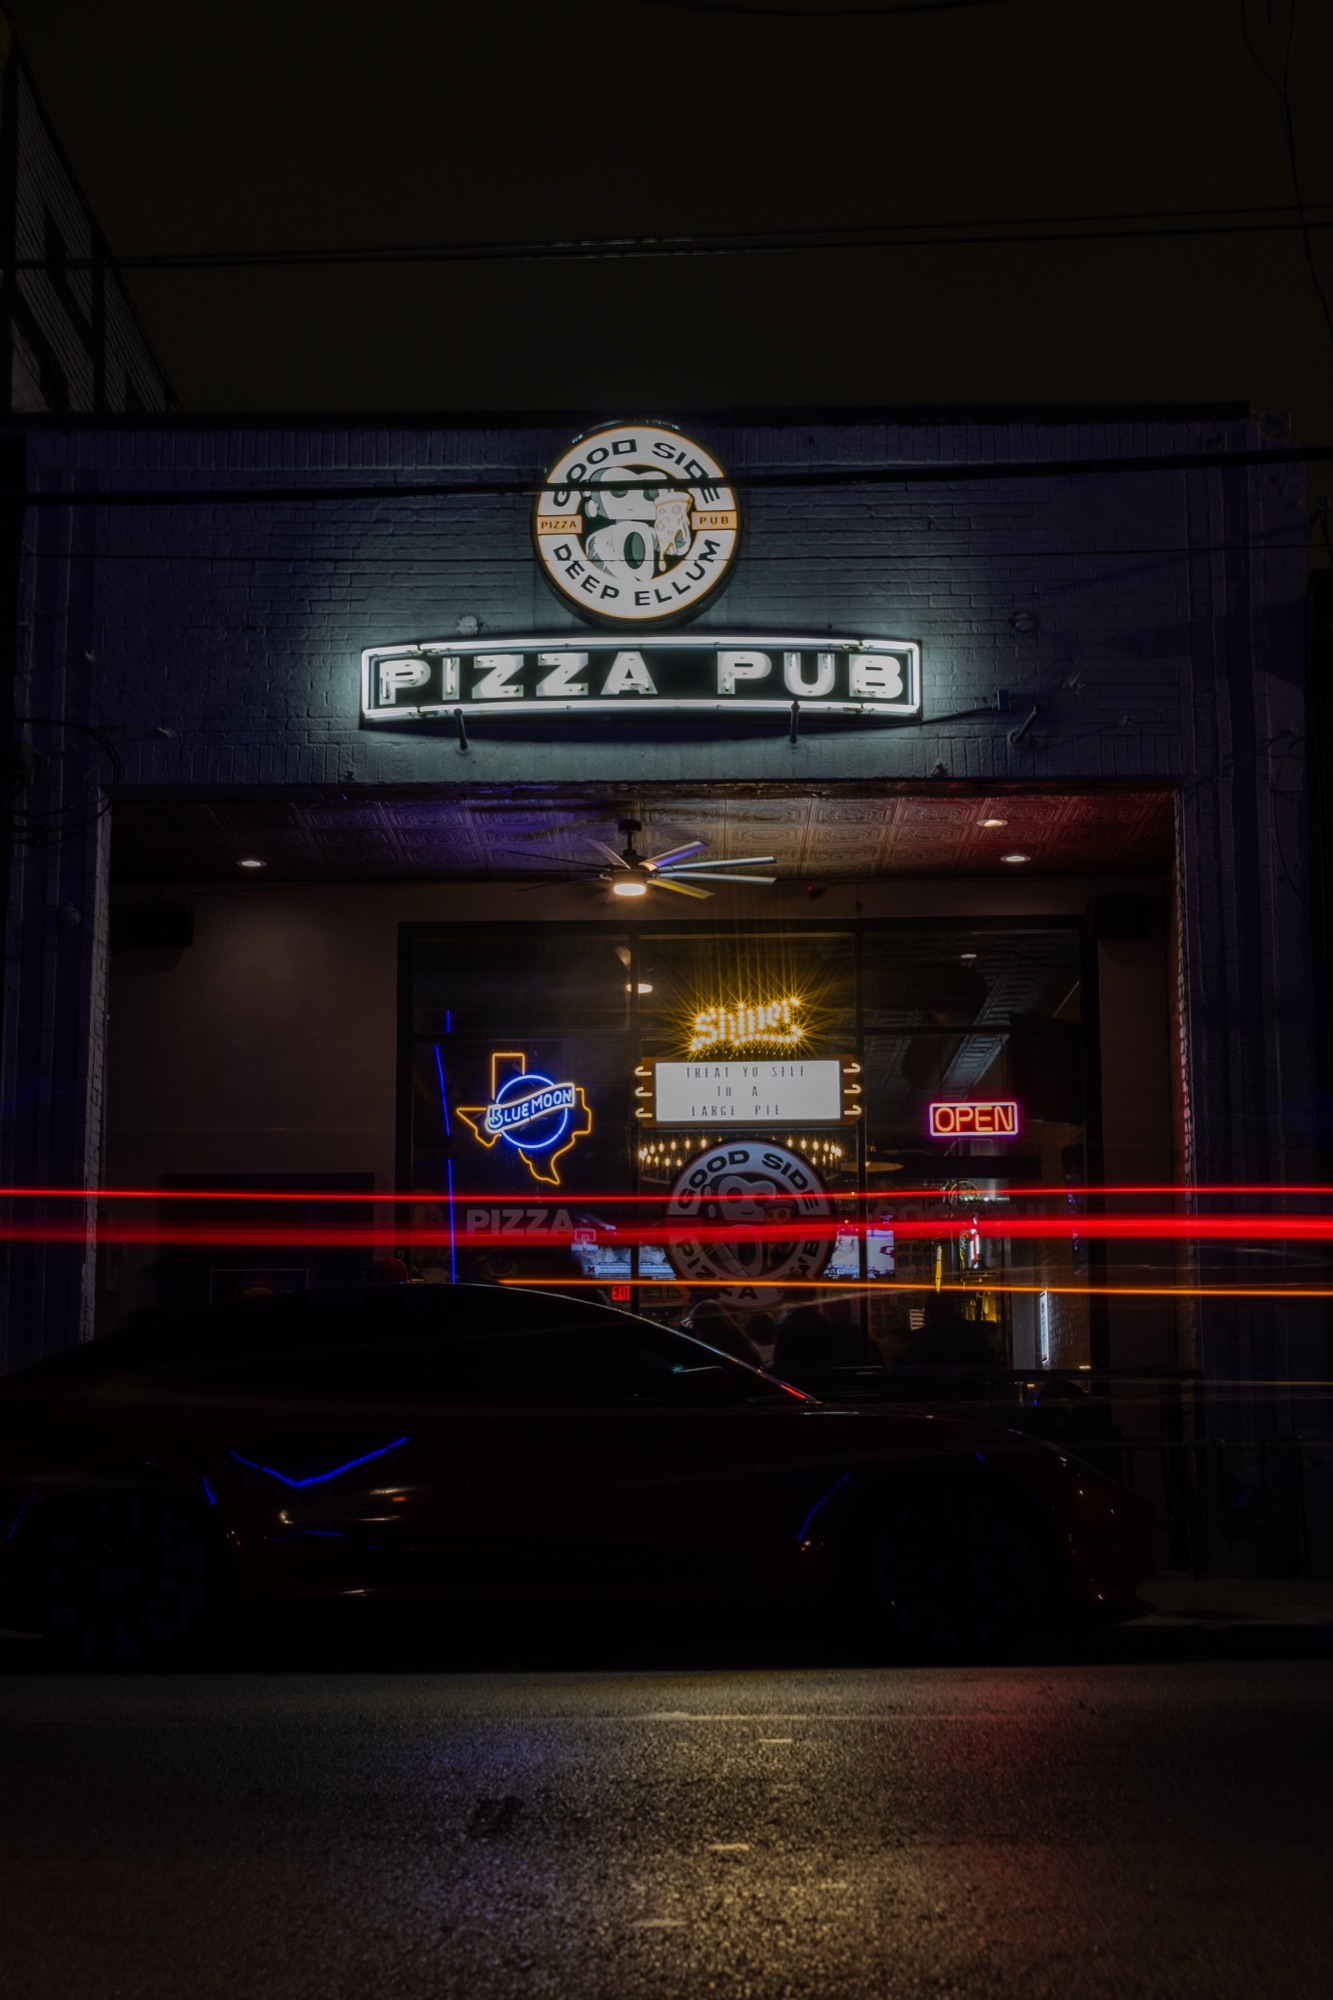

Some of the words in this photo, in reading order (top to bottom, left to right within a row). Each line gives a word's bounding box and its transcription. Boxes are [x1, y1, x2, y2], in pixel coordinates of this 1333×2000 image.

[552, 439, 637, 507] GOOD
[651, 442, 720, 503] SIDE
[541, 521, 577, 530] PIZZA
[699, 516, 729, 525] PUB
[553, 543, 619, 600] DEEP
[634, 538, 721, 606] ELLUM
[378, 650, 658, 705] PIZZA
[717, 651, 901, 699] PUB
[686, 1066, 730, 1078] TREAT
[743, 1066, 758, 1077] YO
[771, 1065, 805, 1077] SELF
[531, 1088, 572, 1114] MOON
[717, 1086, 732, 1097] TO
[752, 1086, 758, 1097] A
[692, 1105, 735, 1117] LARGE
[755, 1104, 779, 1116] PIE
[934, 1106, 1014, 1132] OPEN
[677, 1150, 750, 1210] GOOD
[761, 1153, 820, 1211] SIDE
[467, 1208, 575, 1235] PIZZA
[611, 1285, 631, 1301] EXIT
